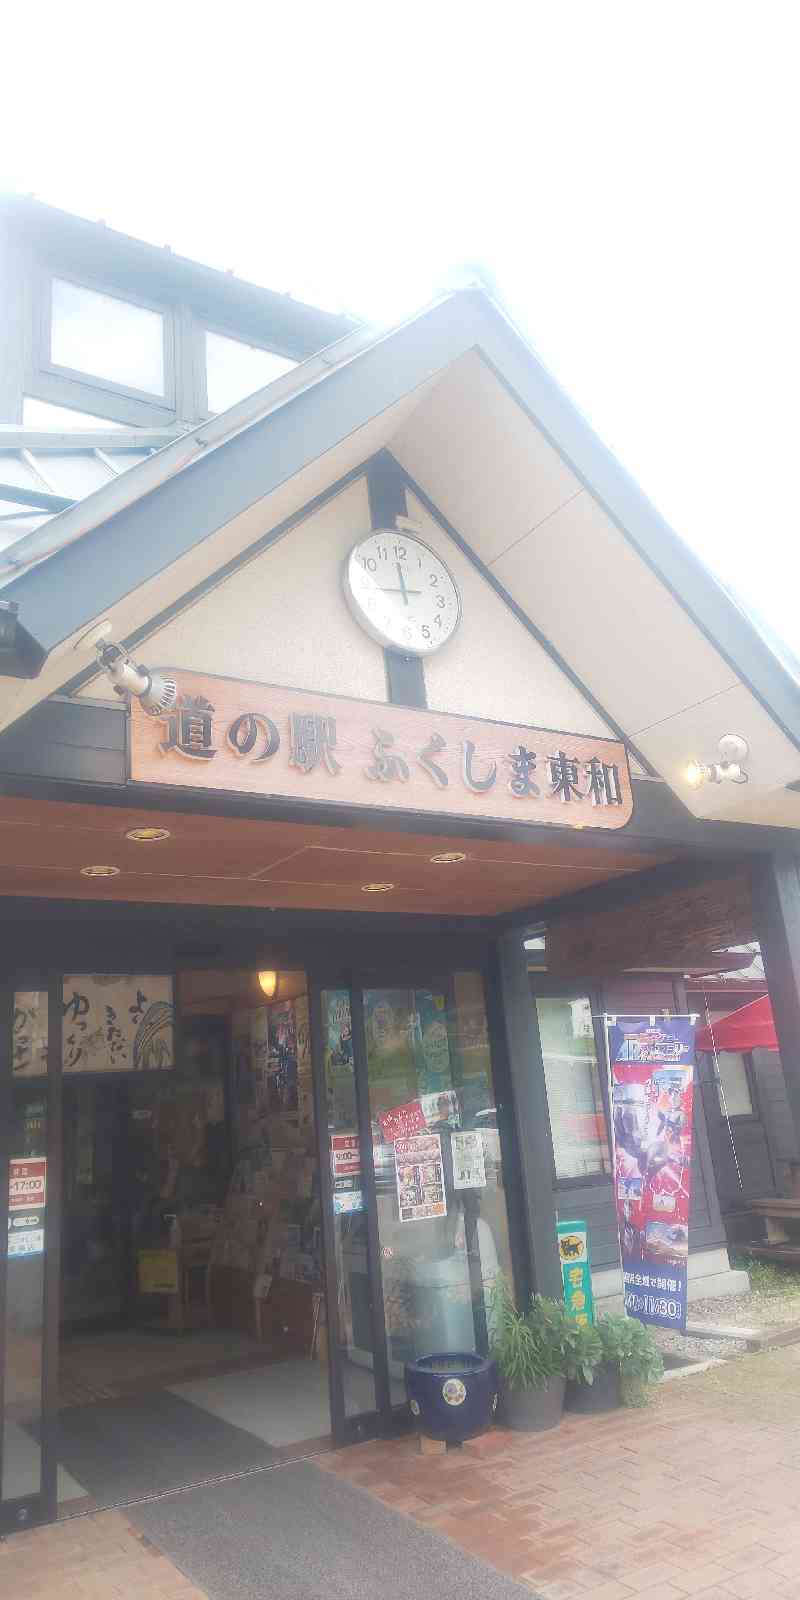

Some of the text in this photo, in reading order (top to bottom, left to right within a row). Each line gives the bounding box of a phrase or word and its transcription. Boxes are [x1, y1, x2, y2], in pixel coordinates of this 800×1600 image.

[376, 545, 388, 561] 11
[393, 544, 407, 561] 12
[362, 557, 377, 573] 10
[430, 573, 438, 588] 2
[436, 594, 446, 610] 3
[434, 614, 442, 628] 4
[421, 624, 431, 639] 5
[156, 693, 623, 806] 道の駅 ふくしま東和
